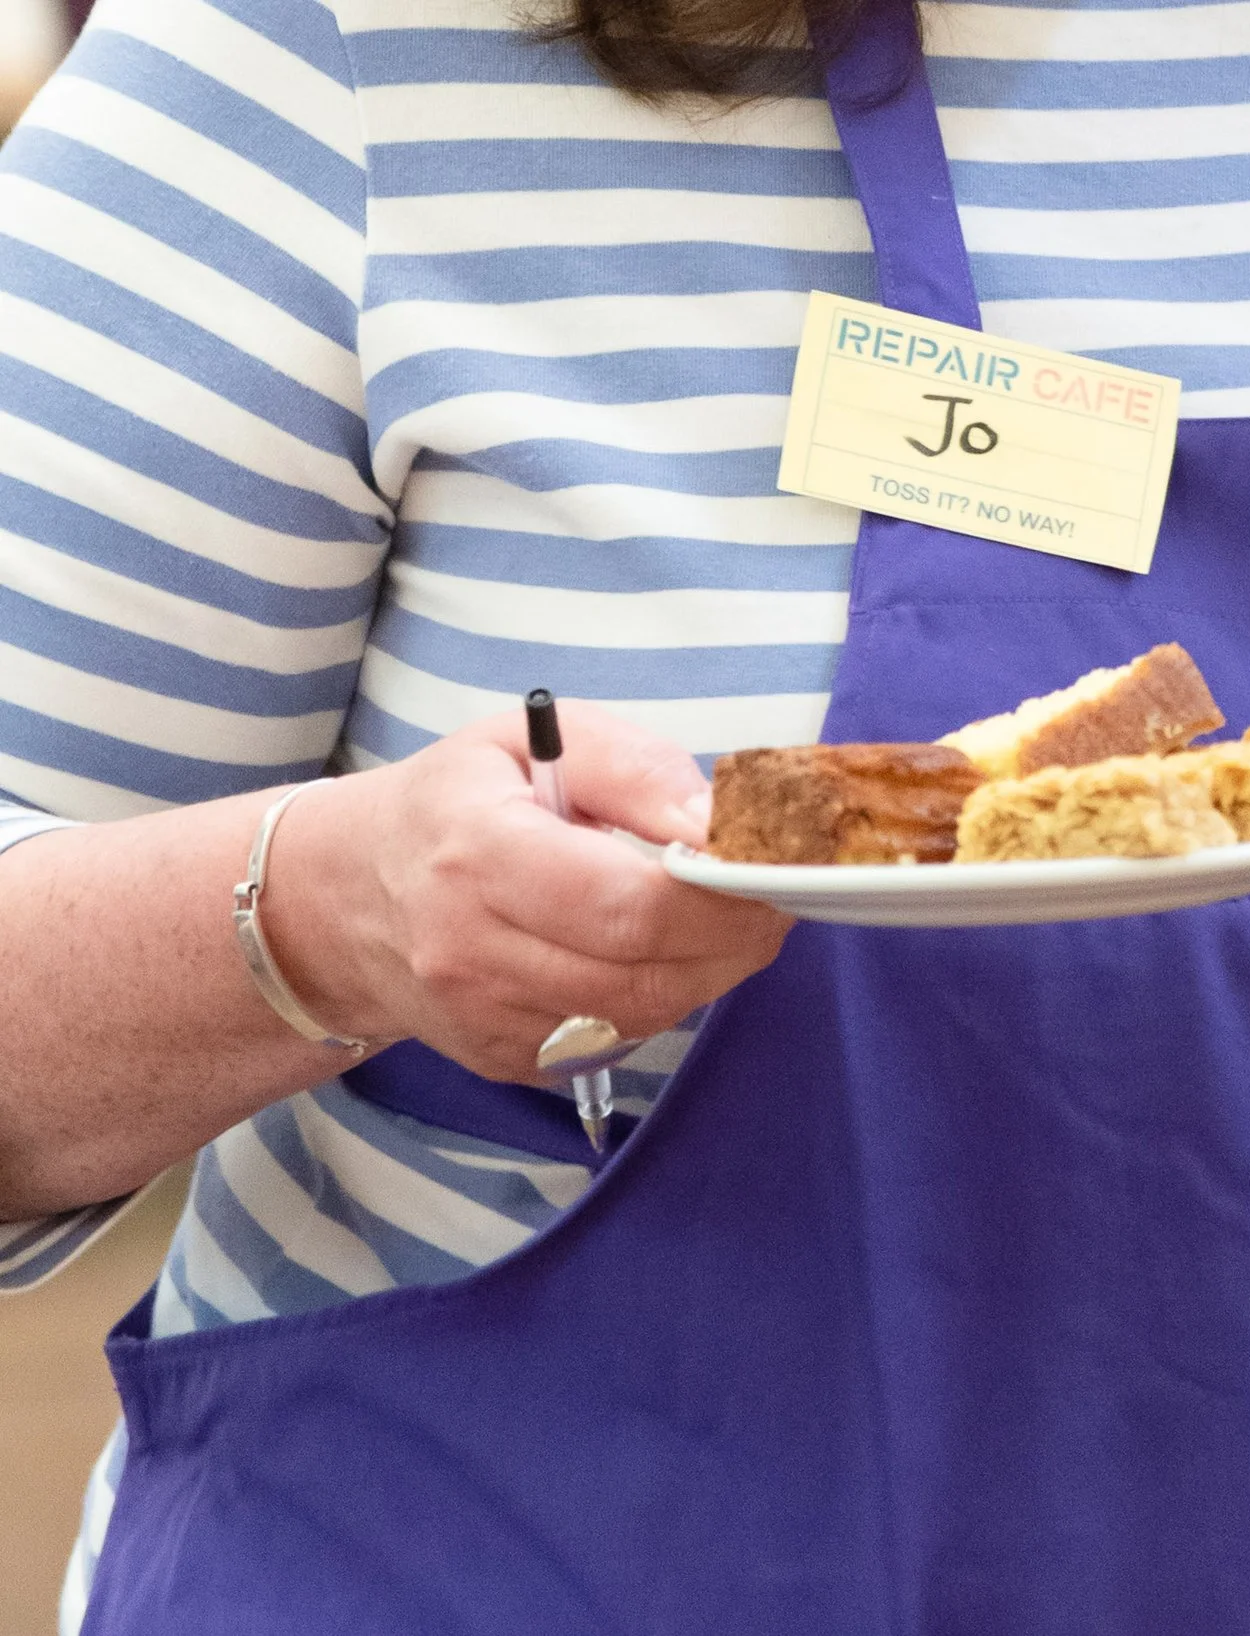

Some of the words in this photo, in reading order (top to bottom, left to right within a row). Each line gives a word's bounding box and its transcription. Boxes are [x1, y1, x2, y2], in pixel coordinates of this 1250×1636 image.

[837, 318, 1020, 391] REPAIR
[1033, 368, 1153, 424] CAFE
[903, 394, 998, 457] Jo
[870, 474, 930, 505] TOSS
[937, 491, 970, 514] IT?
[976, 502, 1011, 524] NO
[1018, 511, 1076, 538] WAY!
